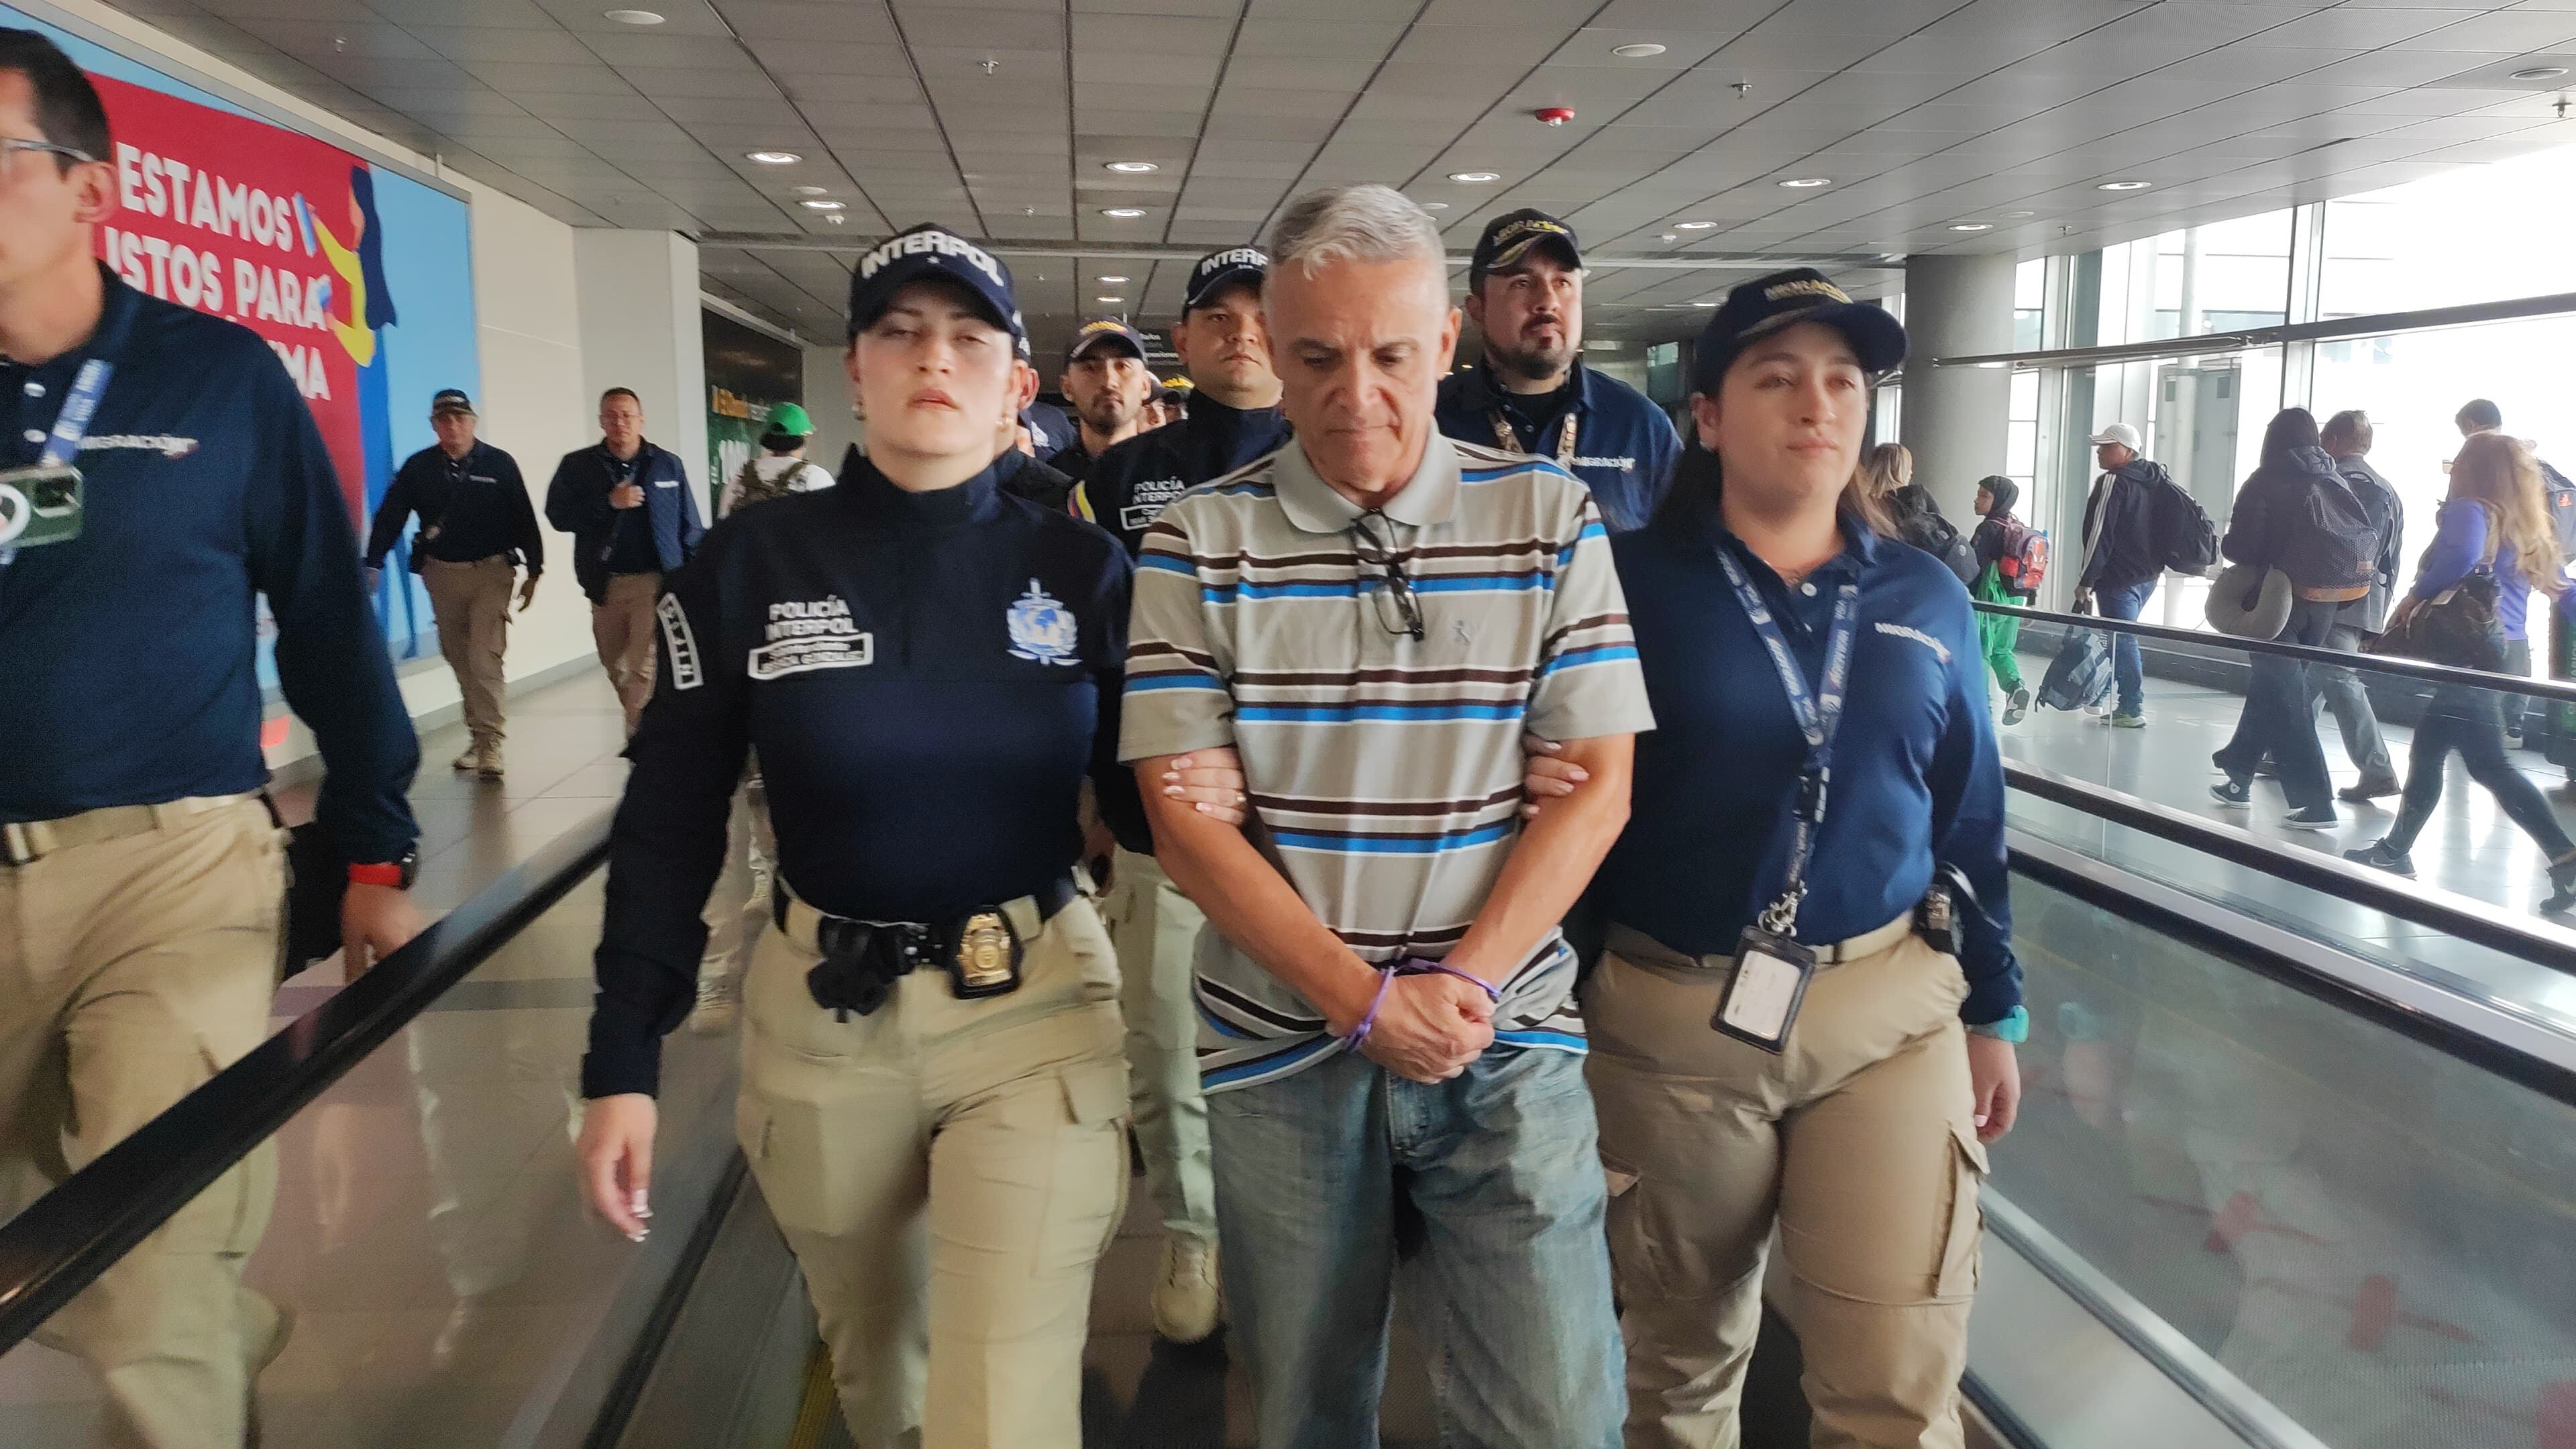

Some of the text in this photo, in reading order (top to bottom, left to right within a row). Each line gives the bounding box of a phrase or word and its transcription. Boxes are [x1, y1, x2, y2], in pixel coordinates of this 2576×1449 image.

[116, 142, 293, 252] ESTAMOS
[861, 230, 1004, 287] INTERPOL
[1201, 248, 1269, 276] INTERP
[105, 225, 329, 331] ISTOS PARA
[1132, 490, 1184, 506] INTERPO
[1134, 476, 1185, 494] POLICÍA
[769, 594, 851, 621] POLICÍA
